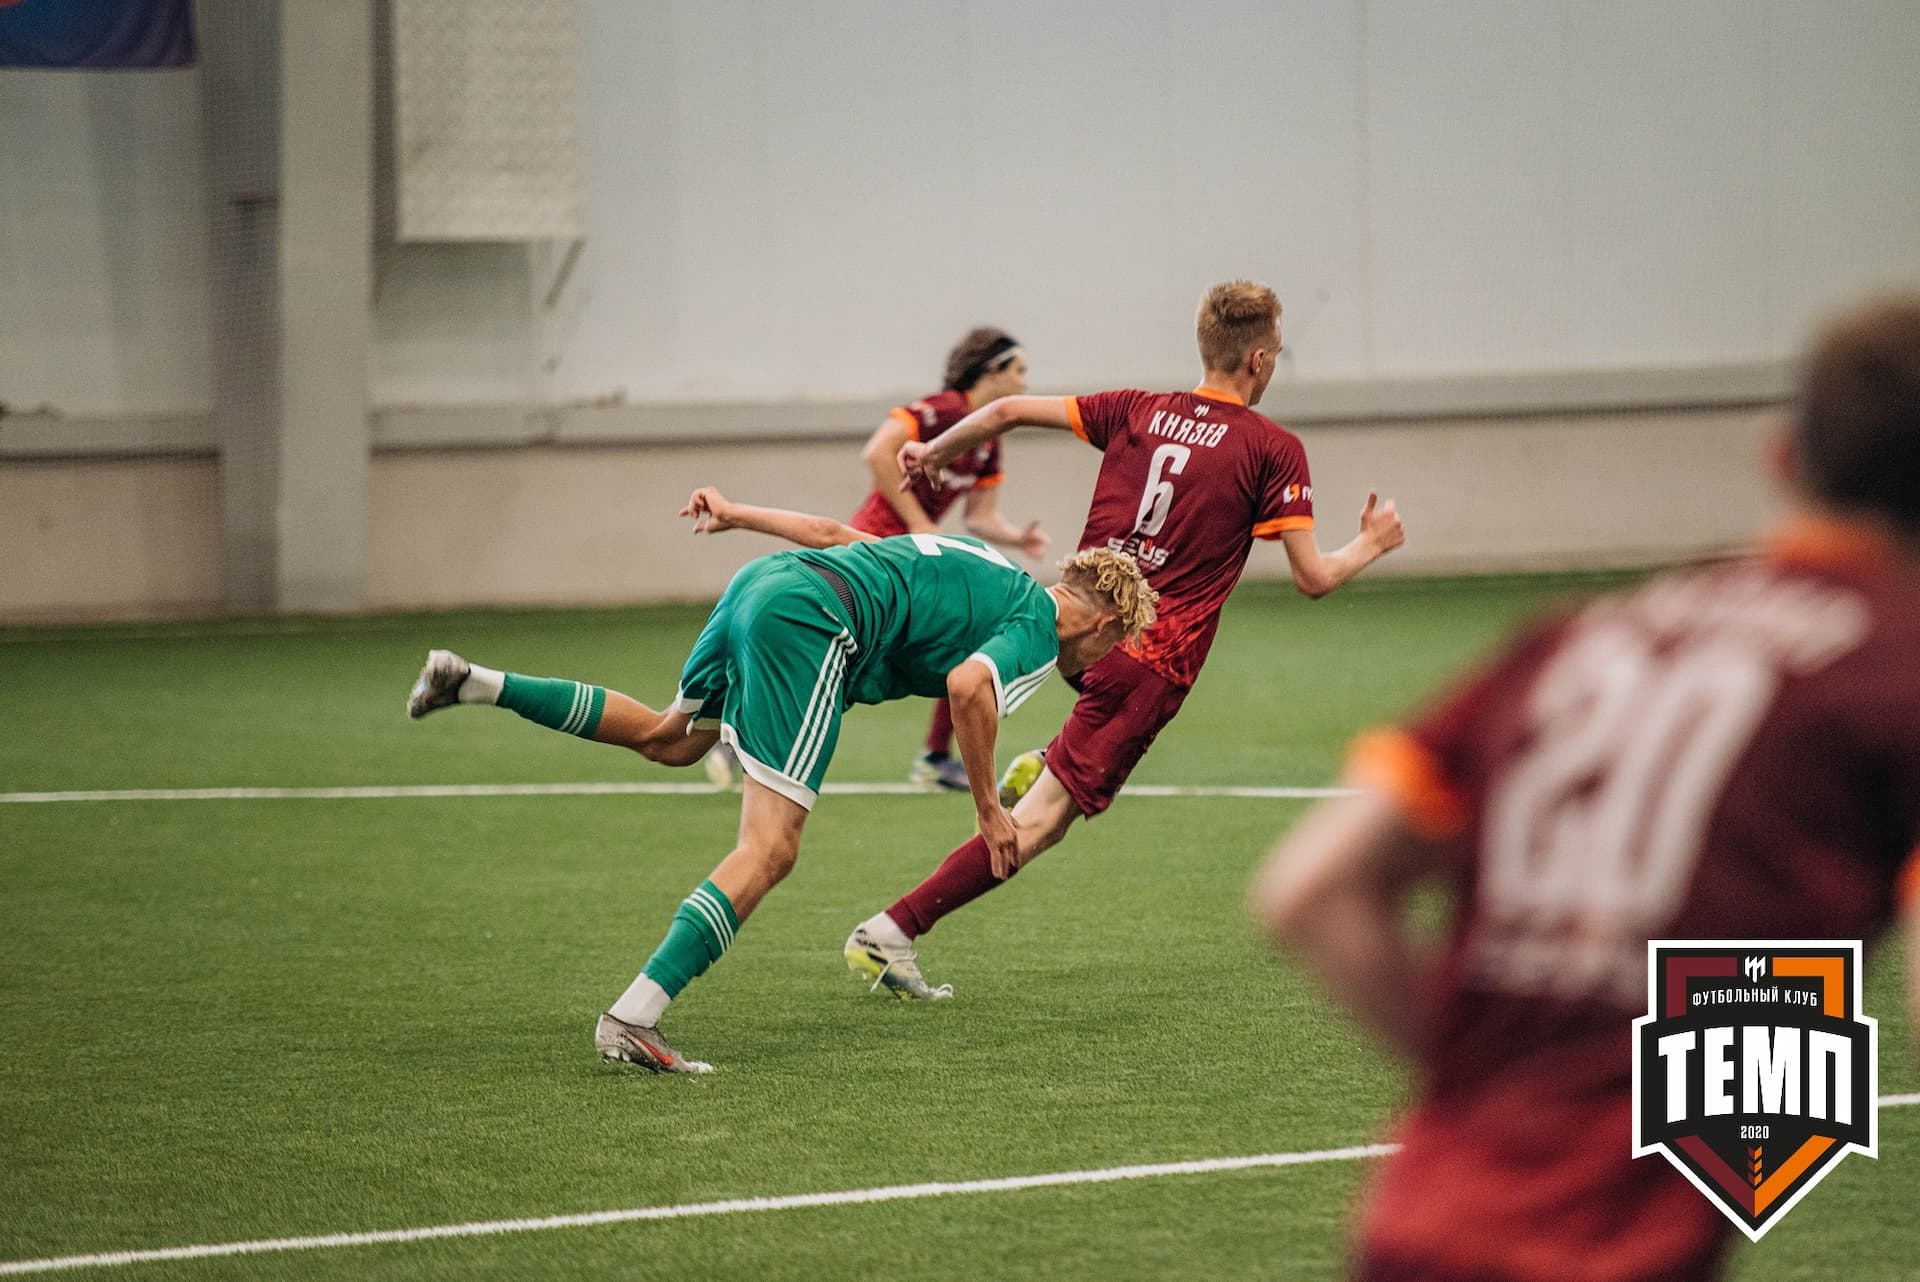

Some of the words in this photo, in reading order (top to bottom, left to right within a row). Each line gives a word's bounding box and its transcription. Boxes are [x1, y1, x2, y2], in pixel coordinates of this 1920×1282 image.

[1148, 410, 1229, 448] КНЯЗЕВ
[1135, 443, 1191, 536] 6
[1483, 620, 1776, 926] 20
